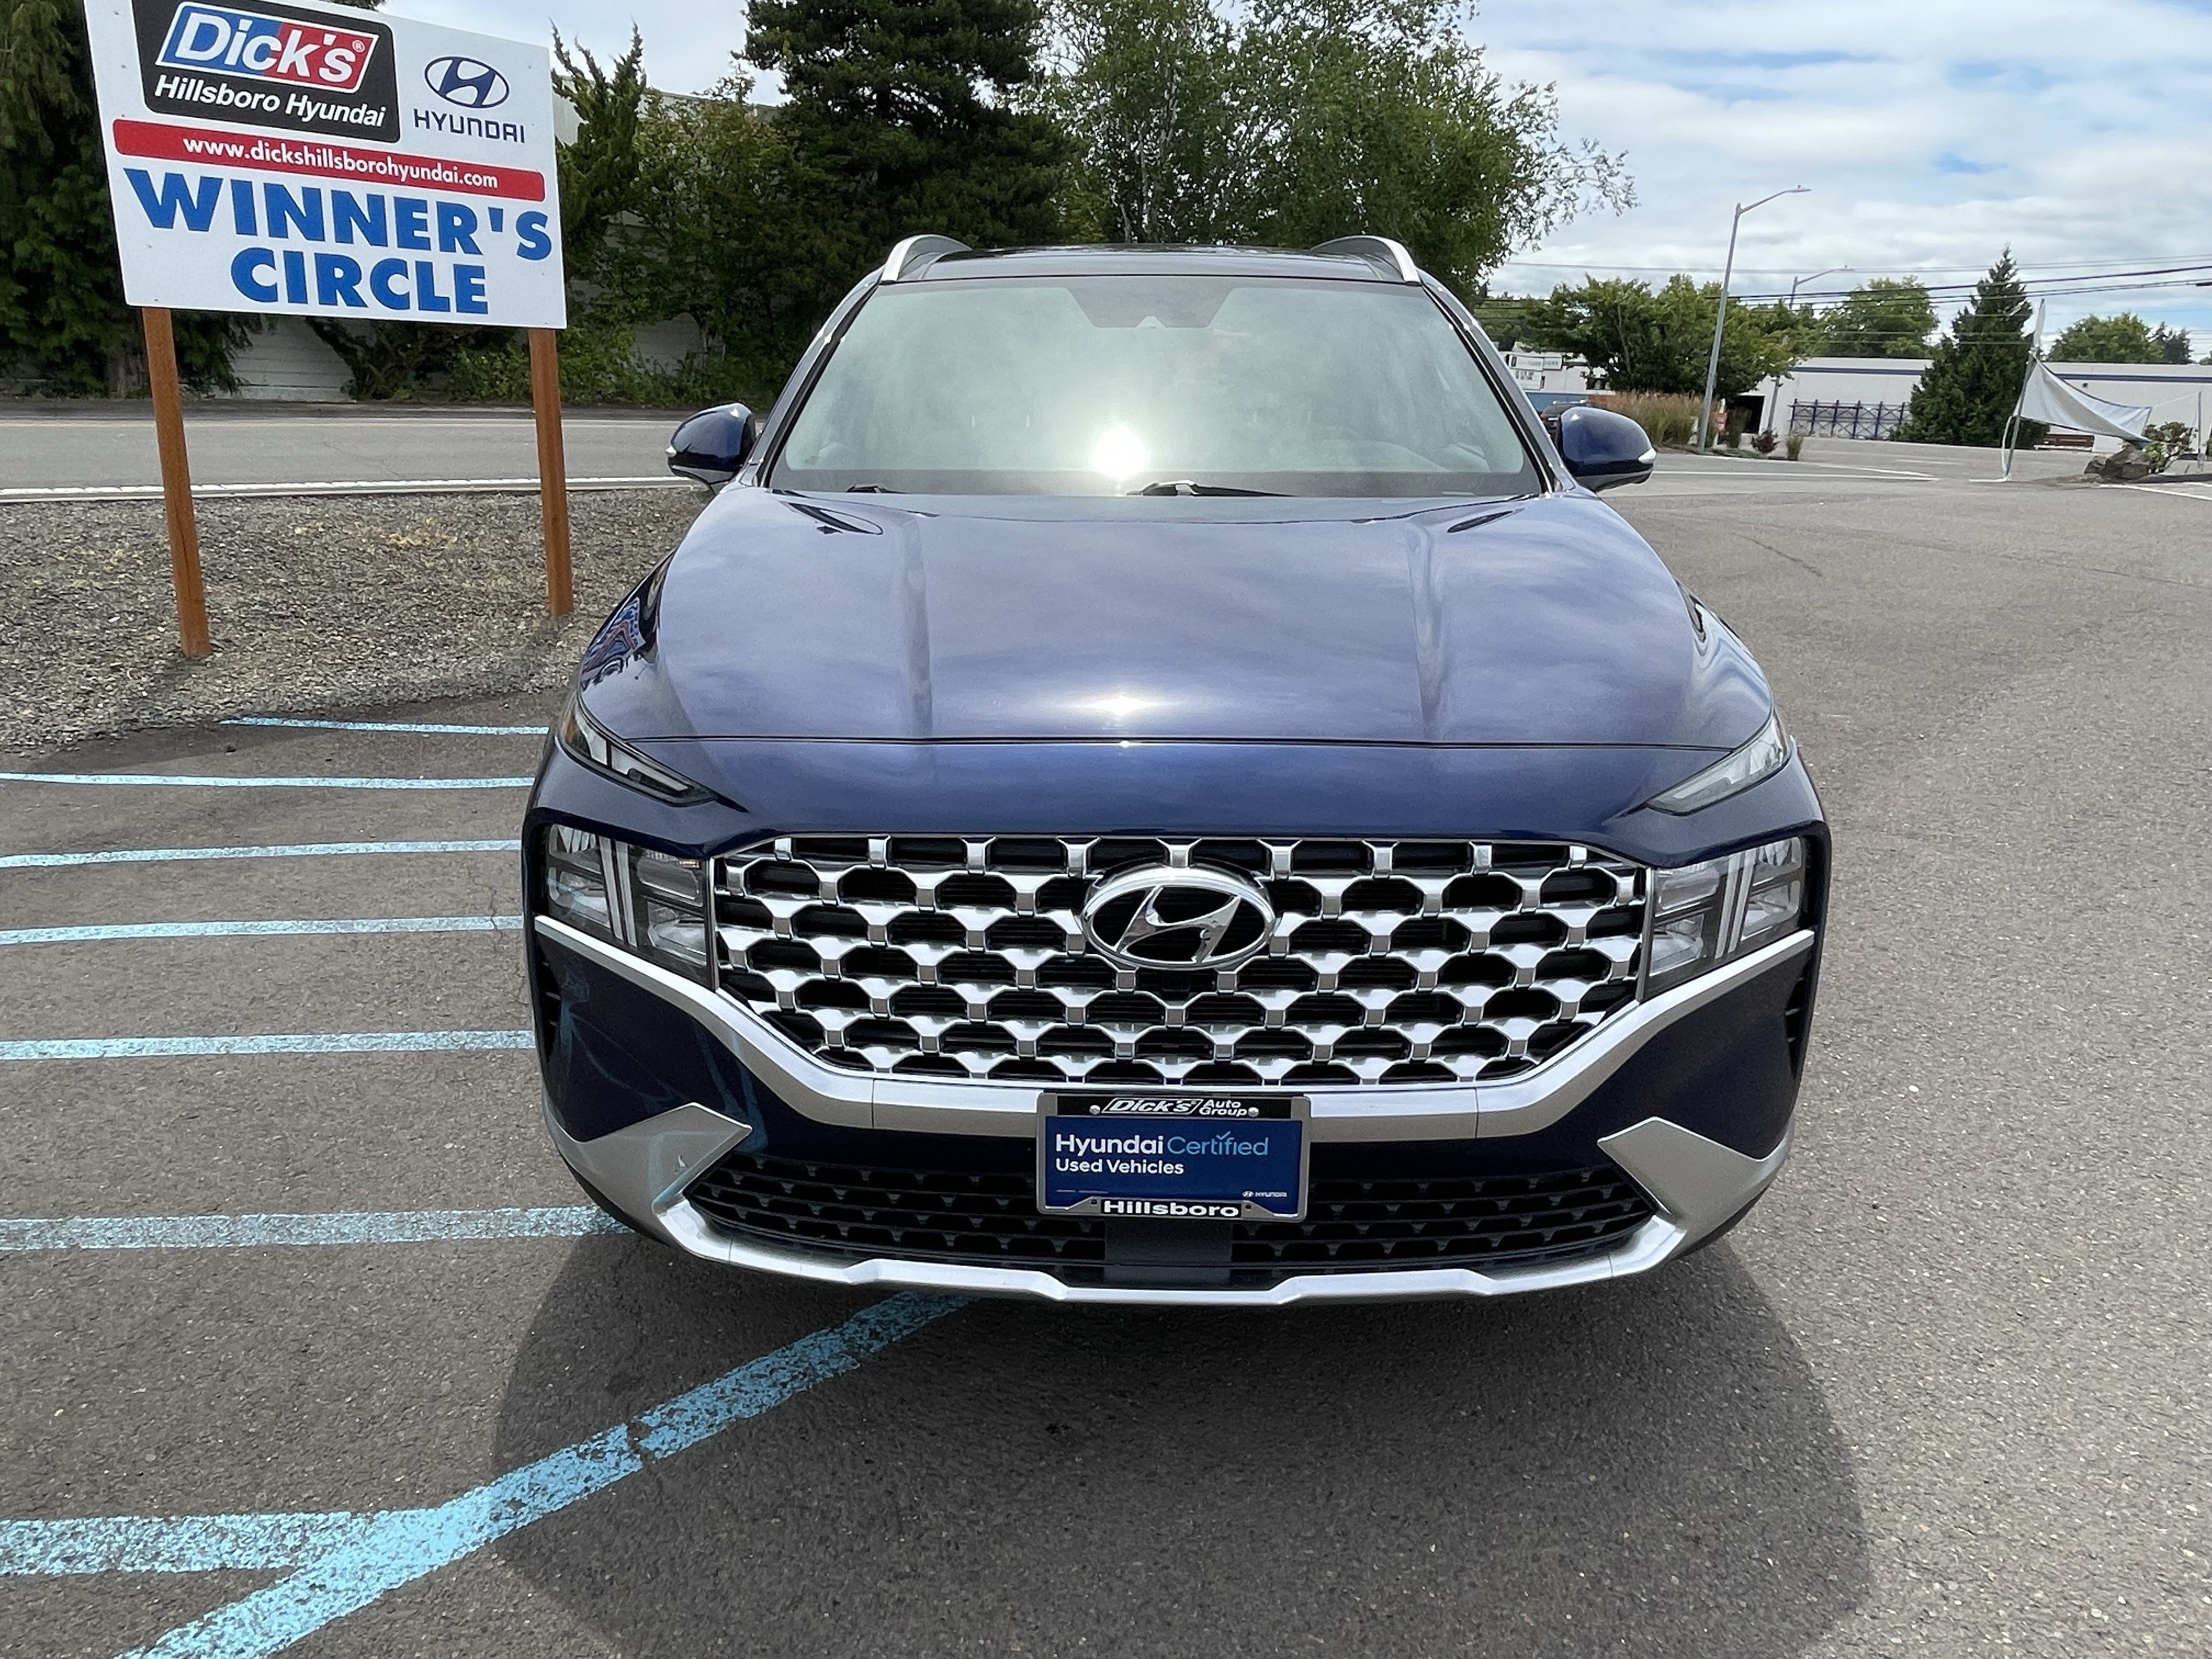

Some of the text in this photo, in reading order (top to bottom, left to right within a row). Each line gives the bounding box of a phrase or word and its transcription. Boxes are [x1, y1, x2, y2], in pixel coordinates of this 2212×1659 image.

[174, 12, 357, 83] Dick's
[155, 75, 386, 128] Hillsboro Hyundai
[414, 108, 524, 143] HYUNDAI
[183, 136, 498, 189] www.dickshillsborohyundai.com
[124, 168, 552, 260] WINNER'S
[231, 247, 488, 314] CIRCLE
[1109, 1099, 1192, 1113] Dick's
[1199, 1107, 1247, 1116] Group
[1203, 1099, 1241, 1108] Auto
[1056, 1131, 1268, 1156] Hyundai Certified
[1056, 1159, 1184, 1174] Used Vehicles
[1104, 1200, 1238, 1217] Hillsboro
